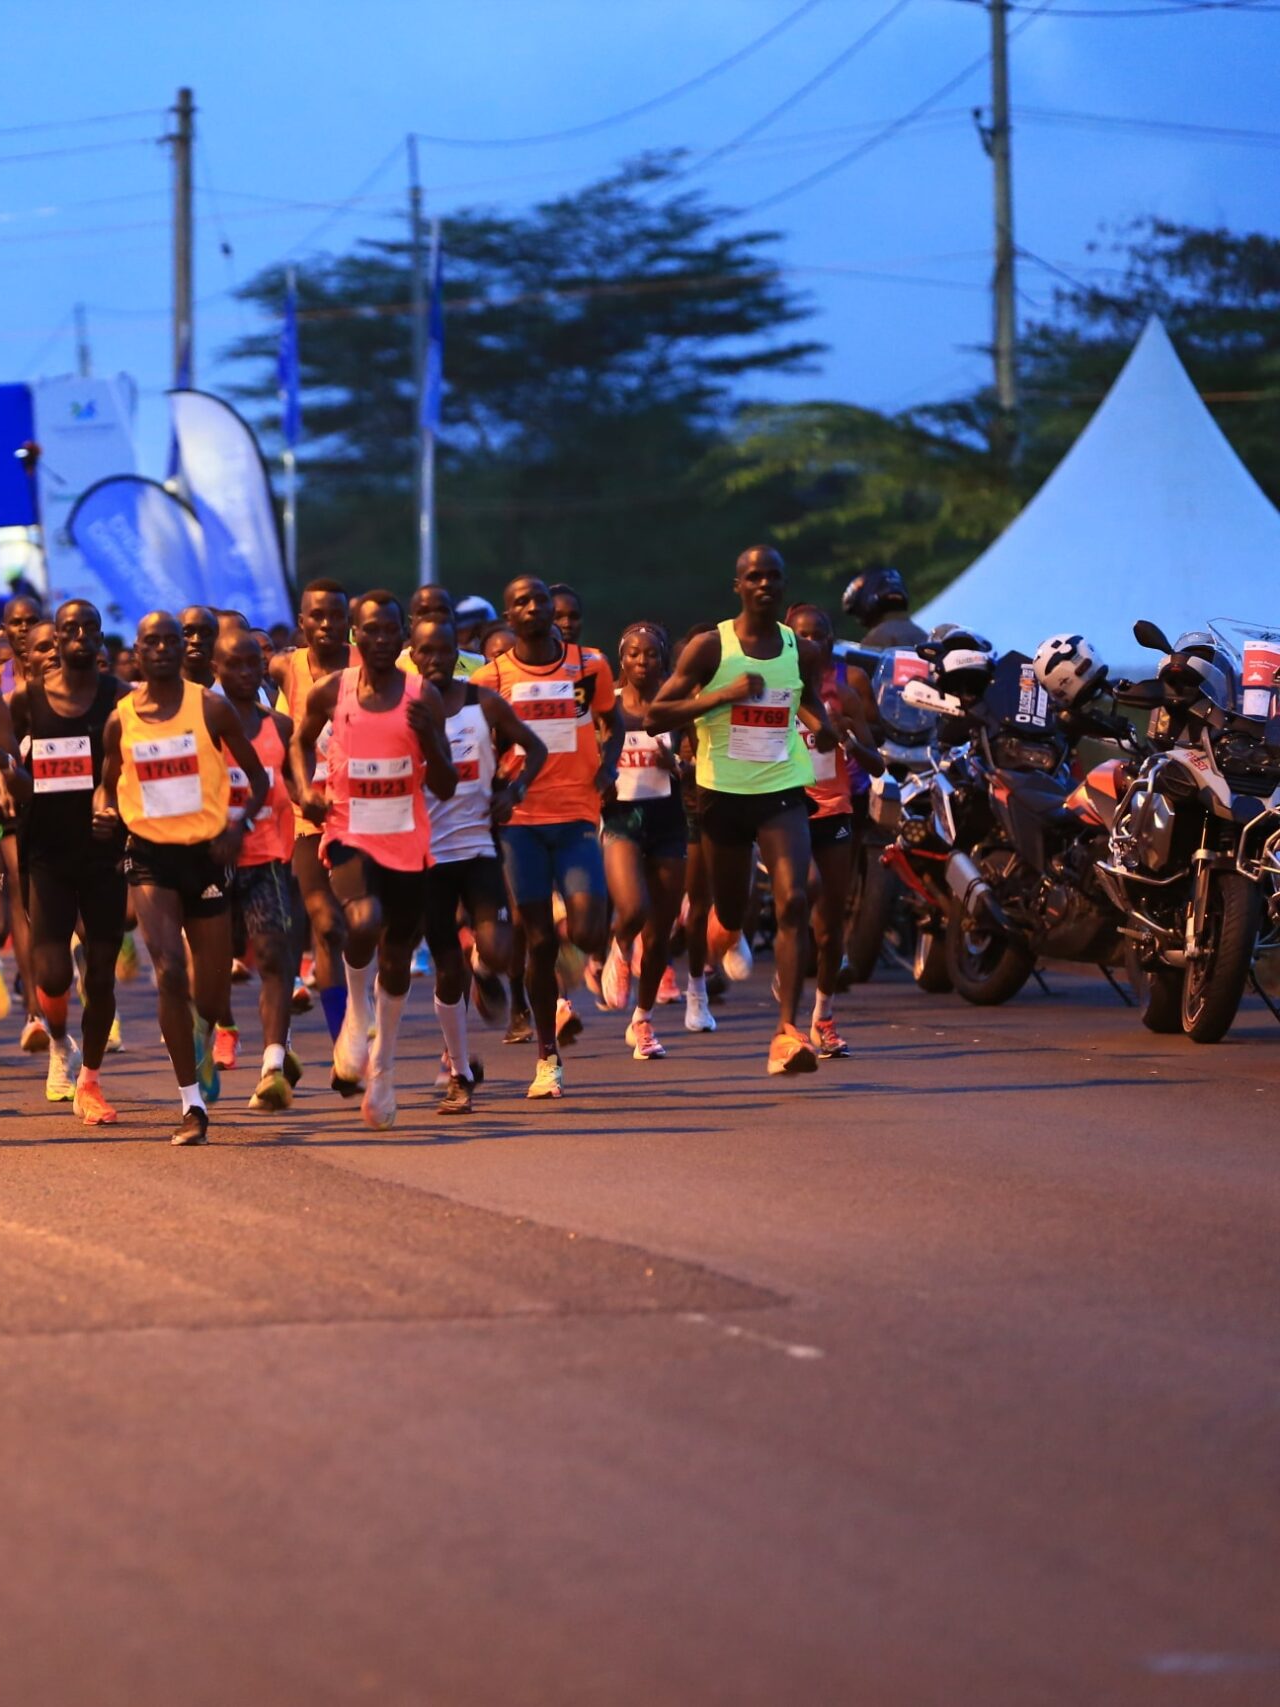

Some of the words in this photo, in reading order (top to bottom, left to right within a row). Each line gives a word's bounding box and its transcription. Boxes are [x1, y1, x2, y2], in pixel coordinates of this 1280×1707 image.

[521, 701, 567, 717] 1531
[742, 710, 784, 724] 1769
[41, 759, 84, 776] 1725
[359, 780, 407, 796] 1823
